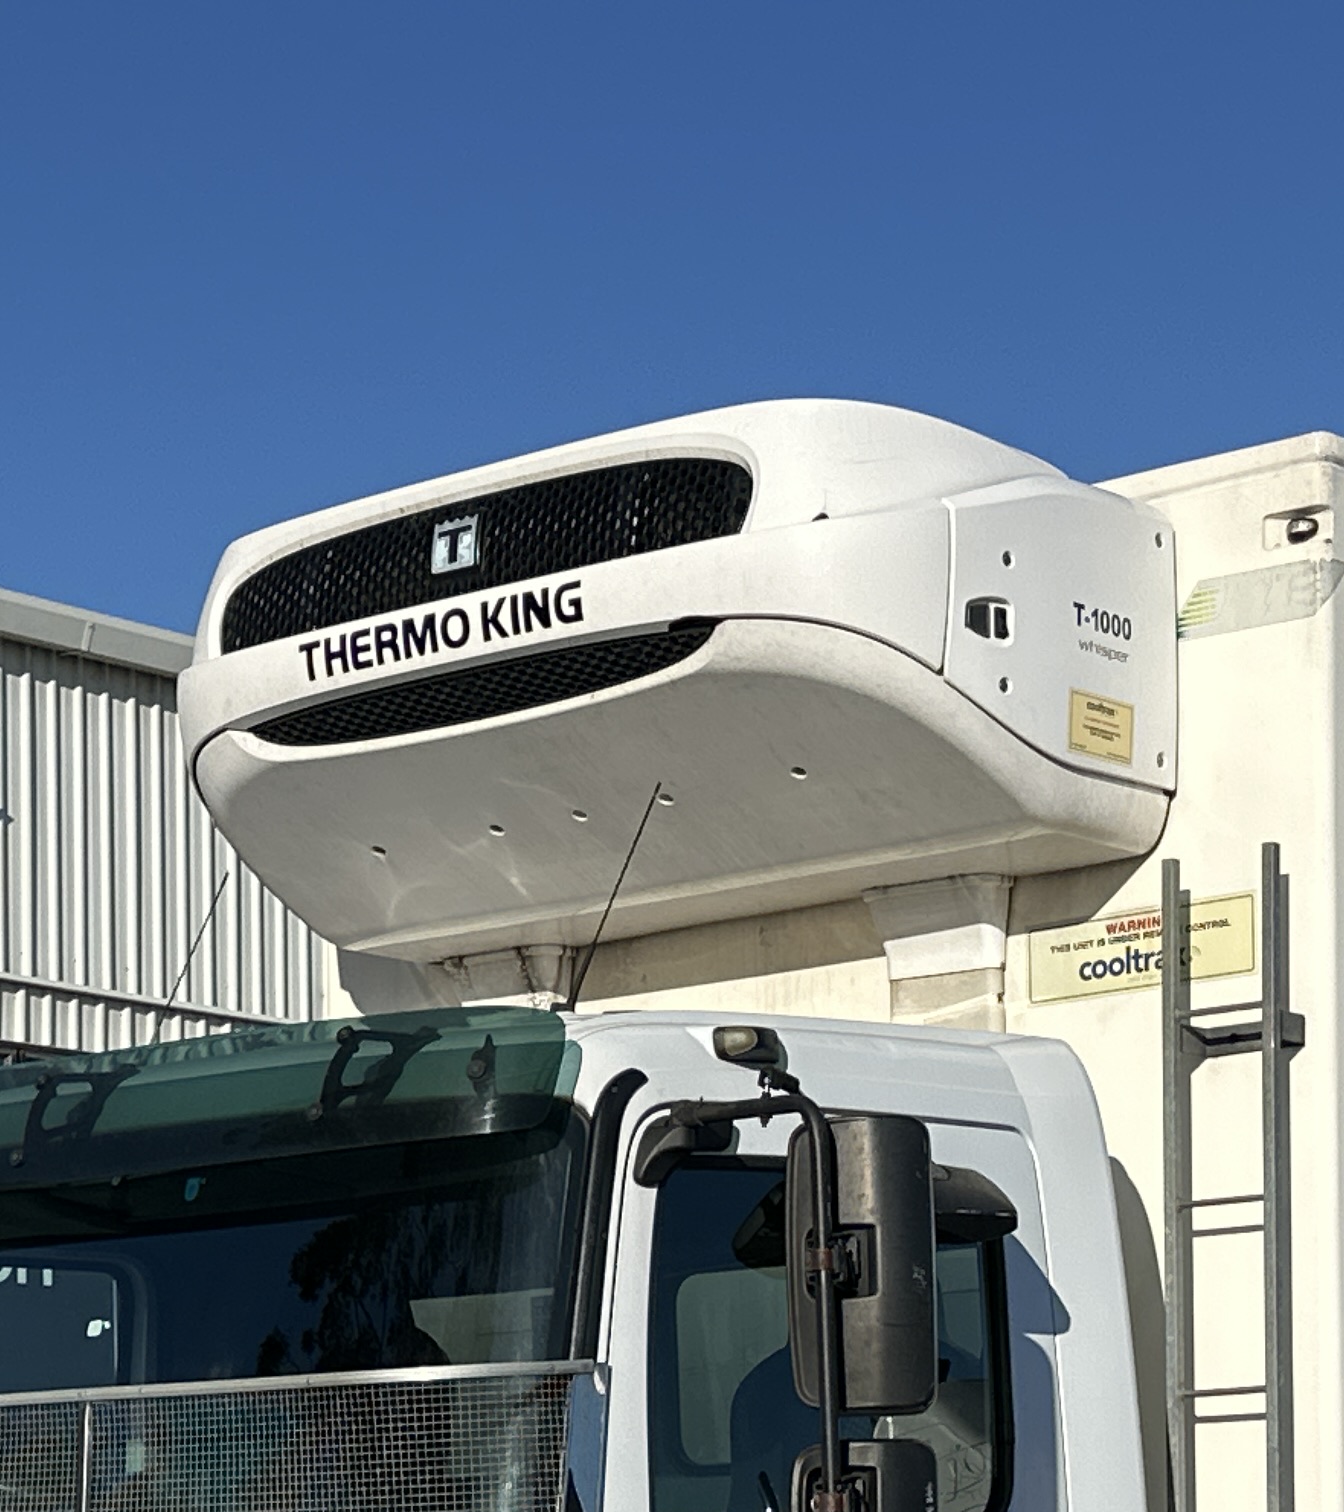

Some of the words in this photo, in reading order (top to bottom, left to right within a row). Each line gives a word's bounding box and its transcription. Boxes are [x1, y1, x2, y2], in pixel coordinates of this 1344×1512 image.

[299, 606, 469, 681] THERMO
[480, 580, 585, 642] KING
[1105, 915, 1161, 935] WARNIN
